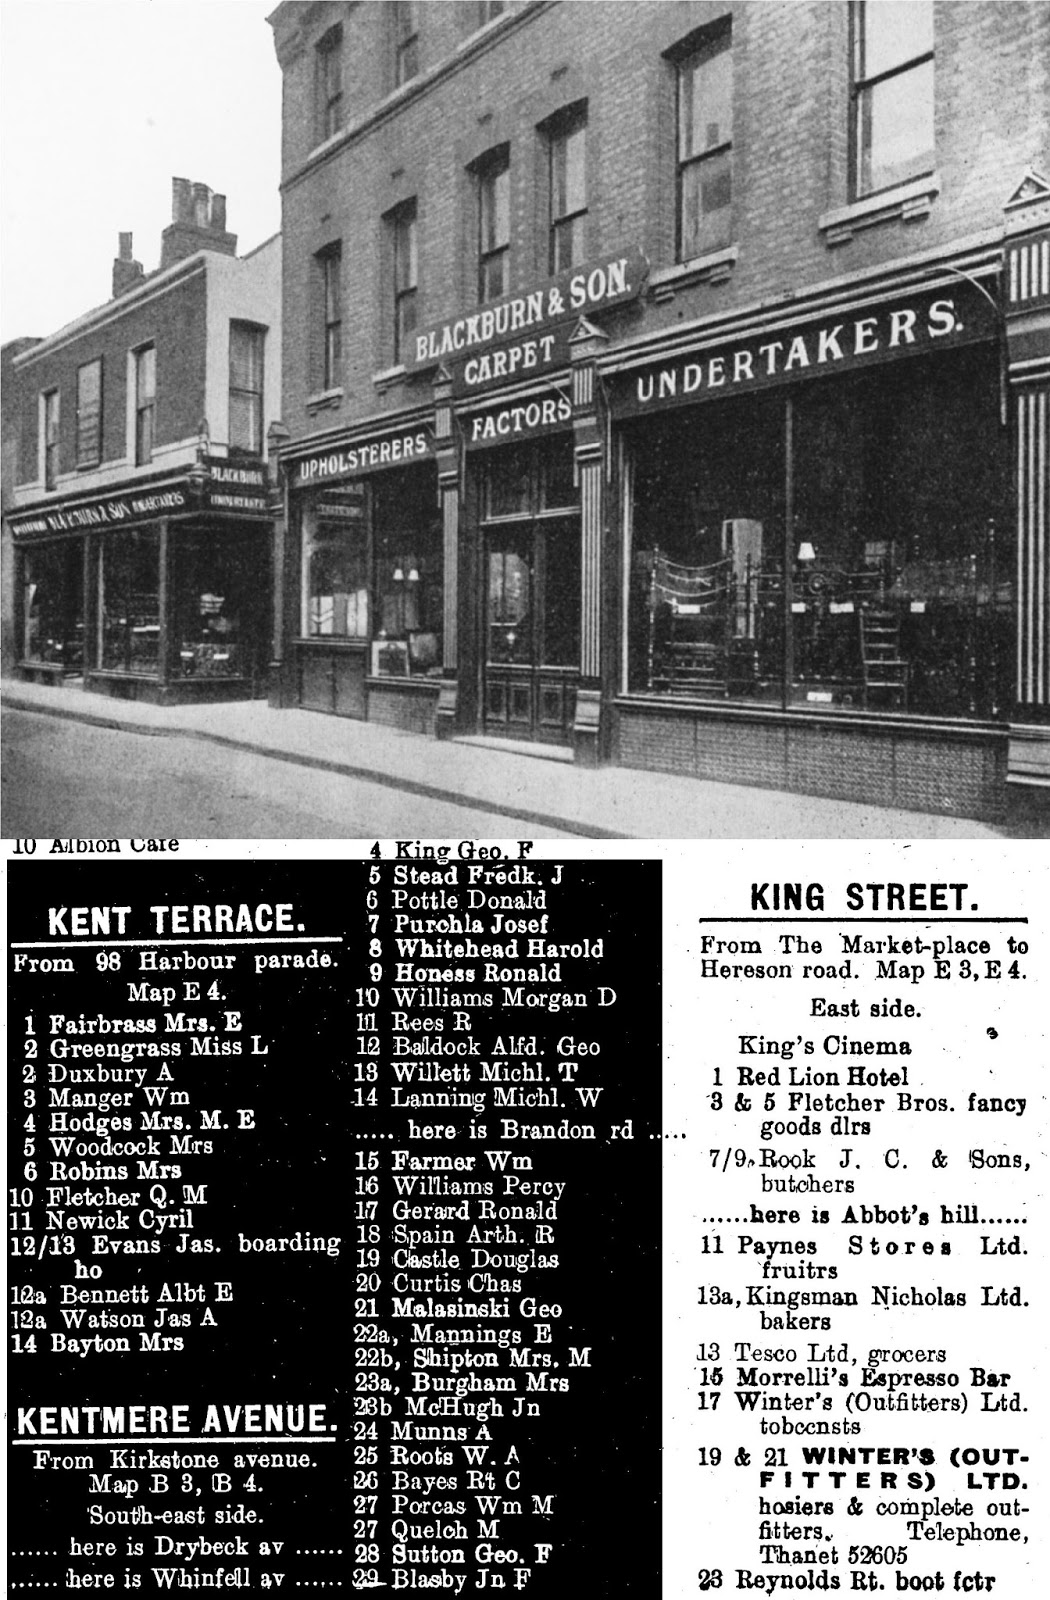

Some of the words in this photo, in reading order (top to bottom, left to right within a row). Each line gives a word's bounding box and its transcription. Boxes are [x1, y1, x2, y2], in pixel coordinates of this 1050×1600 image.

[415, 290, 543, 362] BLACKBURN
[548, 287, 566, 316] &
[570, 258, 632, 307] SON.
[464, 335, 555, 384] CARPET
[637, 300, 964, 402] UNDERTAKERS.
[471, 399, 572, 441] FACTORS
[300, 433, 427, 480] UPHOLSTERERS
[11, 839, 36, 854] 10
[49, 839, 120, 853] Albion
[130, 839, 180, 852] Cafe
[369, 866, 380, 884] 5
[394, 865, 458, 885] Stead
[468, 864, 542, 885] Fredk.
[551, 865, 564, 884] J
[367, 890, 377, 909] 6
[392, 890, 458, 910] Pottle
[467, 890, 546, 910] Donald
[752, 883, 824, 911] KING
[847, 883, 978, 910] STREET.
[49, 906, 131, 935] KENT
[150, 904, 305, 934] TERRACE.
[369, 915, 379, 933] 7
[394, 913, 484, 933] Purchla
[491, 914, 548, 934] Josef
[369, 938, 382, 957] 8
[395, 939, 519, 958] Whitehead
[527, 939, 603, 958] Harold
[701, 936, 762, 953] From
[779, 935, 822, 954] The
[842, 935, 990, 959] Market-place
[1007, 936, 1028, 954] to
[14, 954, 74, 972] From
[96, 952, 121, 971] 98
[139, 951, 236, 970] Harbour
[255, 949, 337, 973] parade.
[370, 963, 382, 982] 9
[395, 963, 475, 982] Honess
[484, 963, 561, 982] Ronald
[701, 959, 791, 979] Hereson
[803, 960, 859, 979] road.
[876, 960, 924, 984] Map
[934, 960, 950, 979] E
[959, 960, 979, 981] 3,
[985, 960, 1001, 979] E
[1008, 960, 1026, 979] 4.
[127, 983, 175, 1006] Map
[183, 982, 200, 1000] E
[207, 979, 226, 1000] 4.
[356, 988, 379, 1007] 10
[392, 986, 492, 1007] Williams
[502, 987, 587, 1012] Morgan
[598, 987, 616, 1006] D
[810, 998, 859, 1017] East
[871, 998, 921, 1017] side.
[25, 1016, 35, 1035] 1
[49, 1014, 156, 1034] Fairbrass
[164, 1013, 215, 1032] Mrs.
[224, 1012, 242, 1031] E
[24, 1039, 37, 1058] 2
[50, 1039, 181, 1062] Greengrass
[190, 1036, 242, 1055] Miss
[251, 1035, 268, 1054] L
[738, 1036, 814, 1059] King's
[824, 1035, 912, 1055] Cinema
[713, 1067, 722, 1086] 1
[737, 1067, 780, 1086] Red
[789, 1067, 840, 1086] Lion
[847, 1066, 908, 1086] Hotel
[24, 1089, 36, 1108] 3
[49, 1088, 133, 1112] Manger
[143, 1087, 190, 1106] Wm
[711, 1092, 722, 1110] 3
[735, 1093, 751, 1112] &
[764, 1093, 775, 1111] 5
[788, 1092, 885, 1111] Fletcher
[897, 1093, 954, 1111] Bros.
[968, 1093, 1026, 1116] fancy
[761, 1116, 821, 1140] goods
[831, 1116, 870, 1135] dlrs
[24, 1138, 35, 1156] 5
[49, 1136, 160, 1156] Woodcock
[169, 1135, 213, 1154] Mrs
[24, 1162, 37, 1181] 6
[50, 1161, 128, 1181] Robins
[137, 1161, 181, 1179] Mrs
[355, 1151, 379, 1170] 15
[391, 1150, 476, 1171] Farmer
[484, 1151, 533, 1171] Wm
[355, 1176, 378, 1195] 16
[393, 1176, 493, 1195] Williams
[503, 1176, 565, 1200] Percy
[10, 1212, 33, 1230] 11
[46, 1210, 129, 1230] Newick
[139, 1208, 193, 1234] Cyril
[11, 1234, 75, 1260] 12/13
[92, 1235, 160, 1254] Evans
[176, 1234, 220, 1253] Jas.
[238, 1232, 341, 1256] boarding
[702, 1235, 723, 1254] 11
[738, 1236, 817, 1259] Paynes
[849, 1235, 951, 1255] Stores
[980, 1236, 1027, 1255] Ltd.
[74, 1259, 102, 1279] ho
[355, 1298, 379, 1317] 21
[392, 1297, 510, 1317] Malasinski
[520, 1298, 562, 1317] Geo
[11, 1334, 37, 1353] 14
[51, 1333, 130, 1357] Bayton
[139, 1332, 184, 1351] Mrs
[353, 1324, 398, 1346] 22a,
[411, 1323, 521, 1348] Mannings
[534, 1324, 552, 1343] E
[355, 1372, 399, 1395] 23a,
[412, 1372, 517, 1396] Burgham
[526, 1372, 569, 1392] Mrs
[700, 1367, 723, 1386] 15
[737, 1367, 848, 1387] Morrelli's
[861, 1368, 959, 1392] Espresso
[970, 1368, 1011, 1387] Bar
[698, 1391, 720, 1410] 17
[734, 1391, 832, 1411] Winter's
[846, 1392, 967, 1414] (Outfitters)
[981, 1392, 1027, 1412] Ltd.
[18, 1405, 189, 1434] KENTMERE
[201, 1404, 337, 1433] AVENUE.
[760, 1416, 861, 1435] tobccnsts
[33, 1450, 93, 1469] From
[110, 1449, 219, 1469] Kirkstone
[234, 1454, 317, 1468] avenue.
[354, 1446, 378, 1464] 25
[390, 1446, 453, 1465] Roots
[462, 1446, 495, 1465] W.
[504, 1445, 519, 1465] A
[90, 1505, 205, 1525] South-east
[215, 1504, 263, 1523] side.
[354, 1520, 378, 1538] 27
[392, 1519, 468, 1543] Quelch
[477, 1519, 500, 1538] M
[759, 1520, 831, 1542] fitters.
[907, 1521, 1028, 1546] Telephone,
[355, 1544, 379, 1563] 28
[392, 1544, 465, 1564] Sutton
[475, 1544, 524, 1563] Geo.
[534, 1544, 552, 1563] F
[760, 1545, 838, 1564] Thanet
[848, 1545, 907, 1564] 52605
